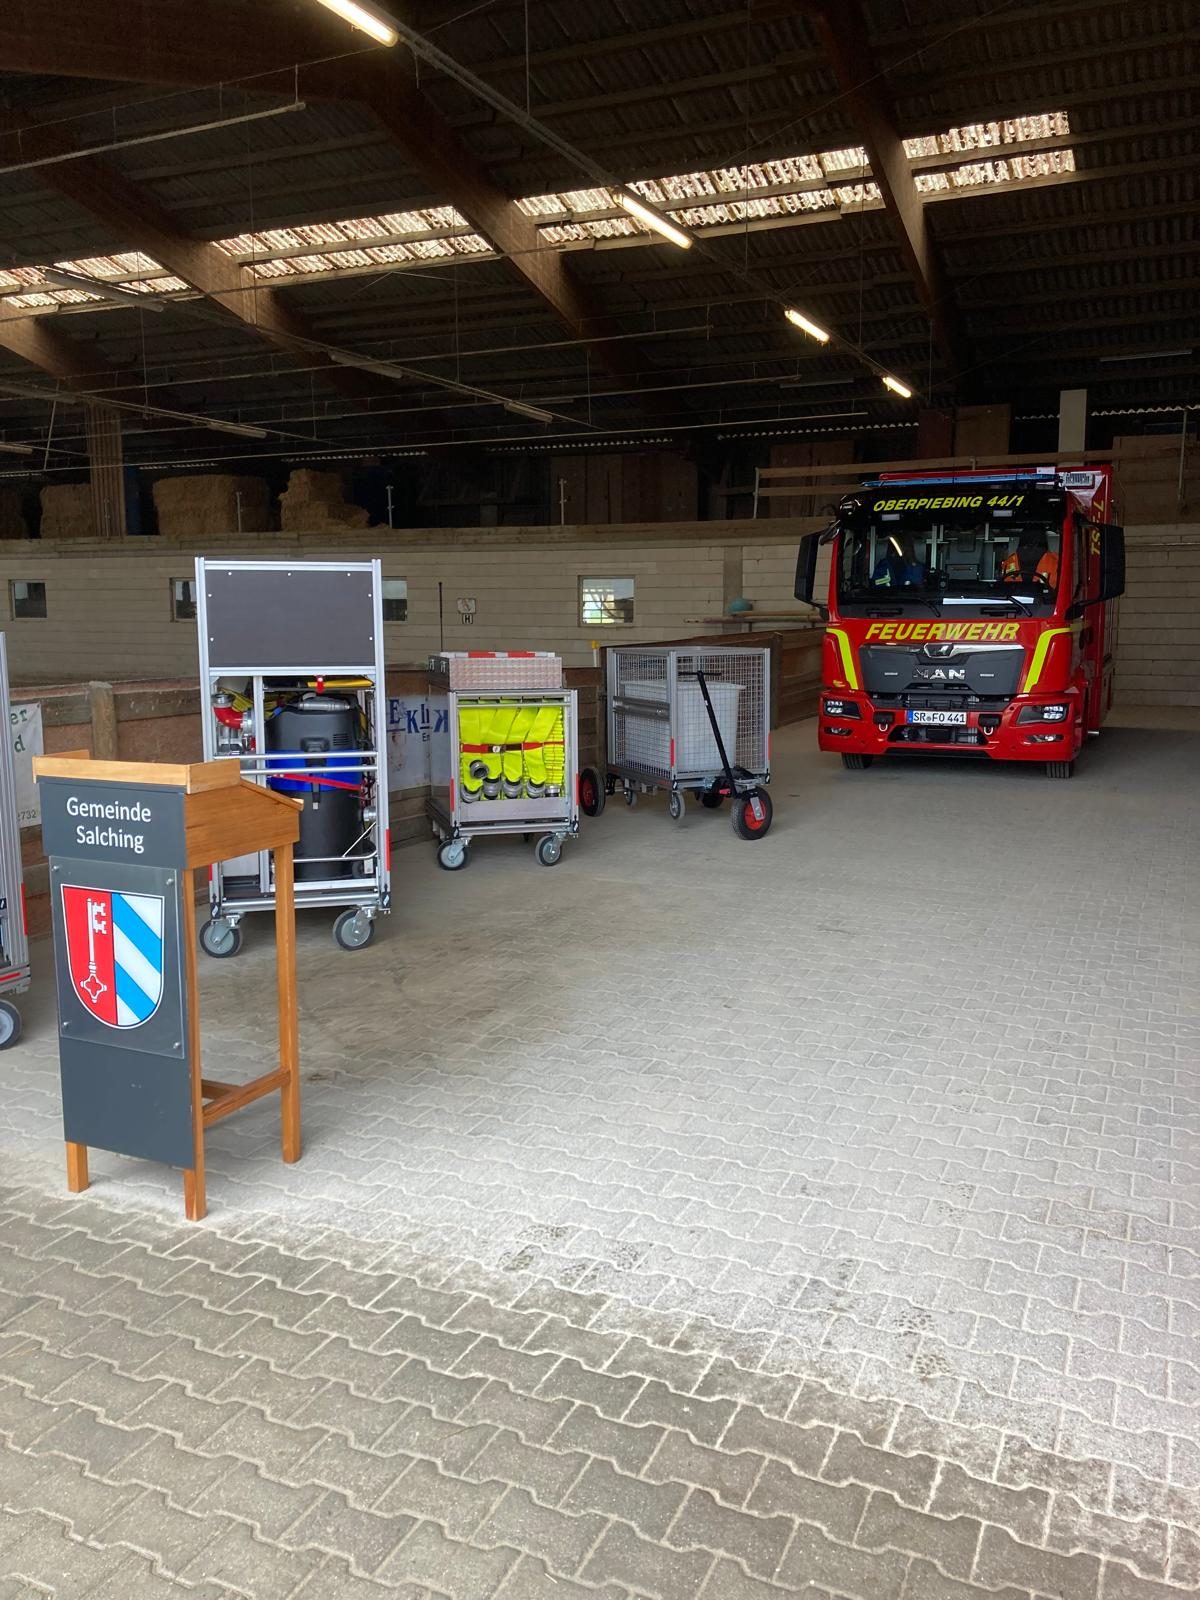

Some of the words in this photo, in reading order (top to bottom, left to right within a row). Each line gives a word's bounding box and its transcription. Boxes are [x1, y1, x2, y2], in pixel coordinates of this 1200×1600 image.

[873, 496, 984, 512] OBERPIEBING
[987, 495, 1025, 507] 44/1
[865, 622, 1020, 641] FEUERWEHR
[912, 668, 965, 680] MAN
[10, 708, 28, 726] er
[913, 712, 926, 722] SR
[932, 712, 945, 722] FO
[947, 713, 965, 723] 441
[66, 797, 151, 822] Gemeinde
[76, 825, 144, 854] Salching
